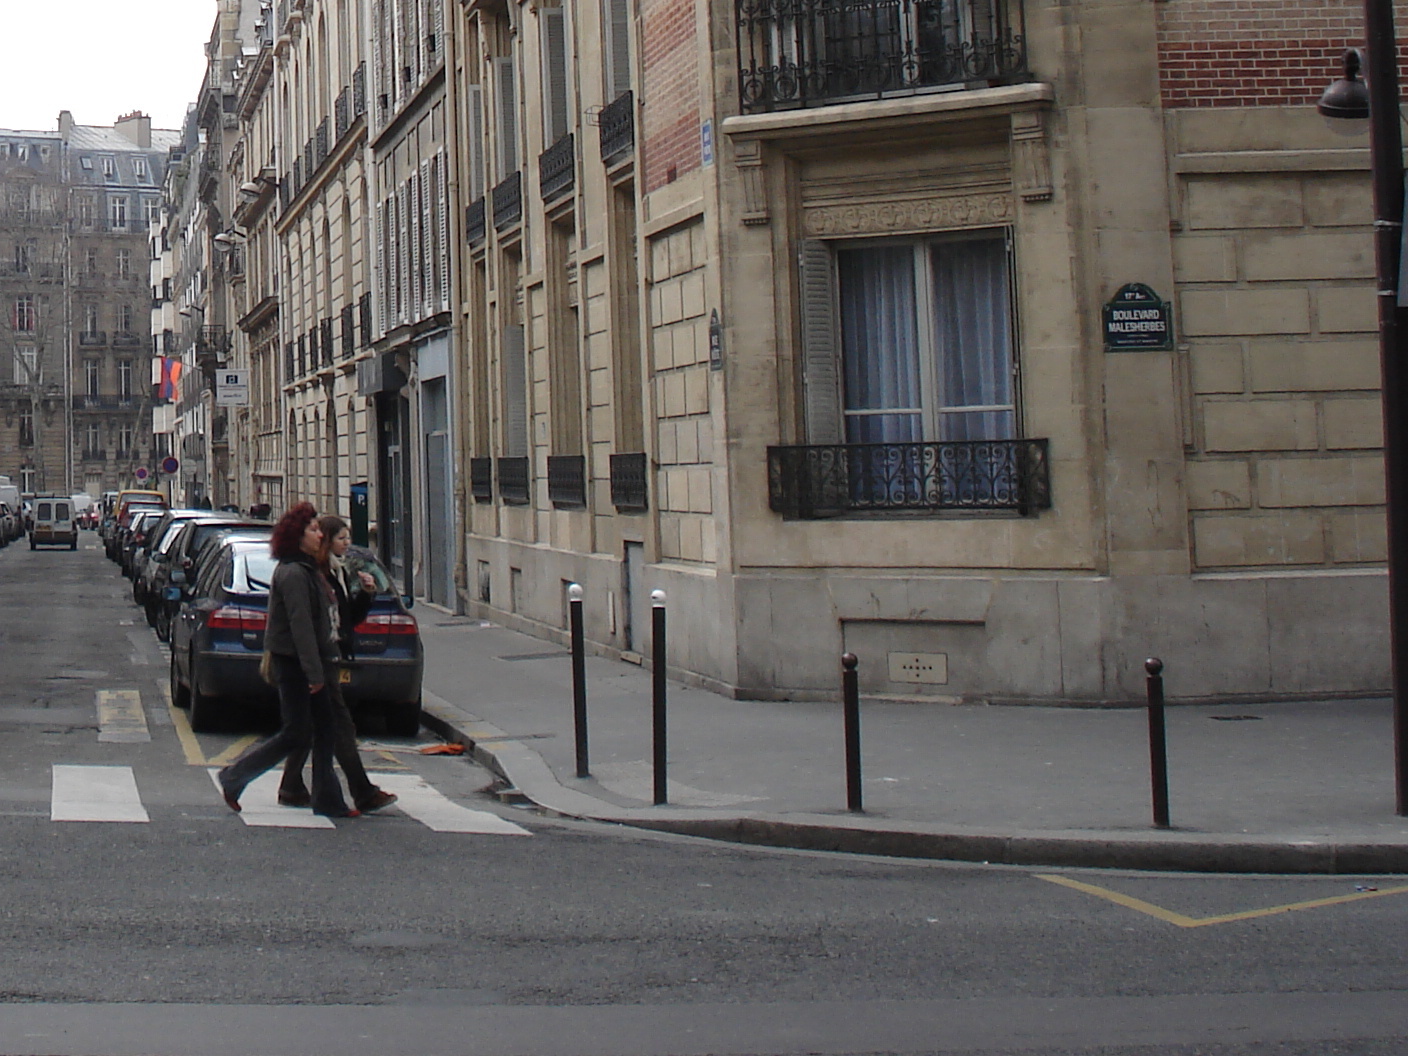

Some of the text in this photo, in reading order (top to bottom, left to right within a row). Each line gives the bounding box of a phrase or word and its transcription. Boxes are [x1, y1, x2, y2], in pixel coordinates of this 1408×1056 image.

[1113, 309, 1160, 321] BOULEVARD
[1108, 321, 1166, 332] MALESHERBES
[358, 494, 366, 504] P
